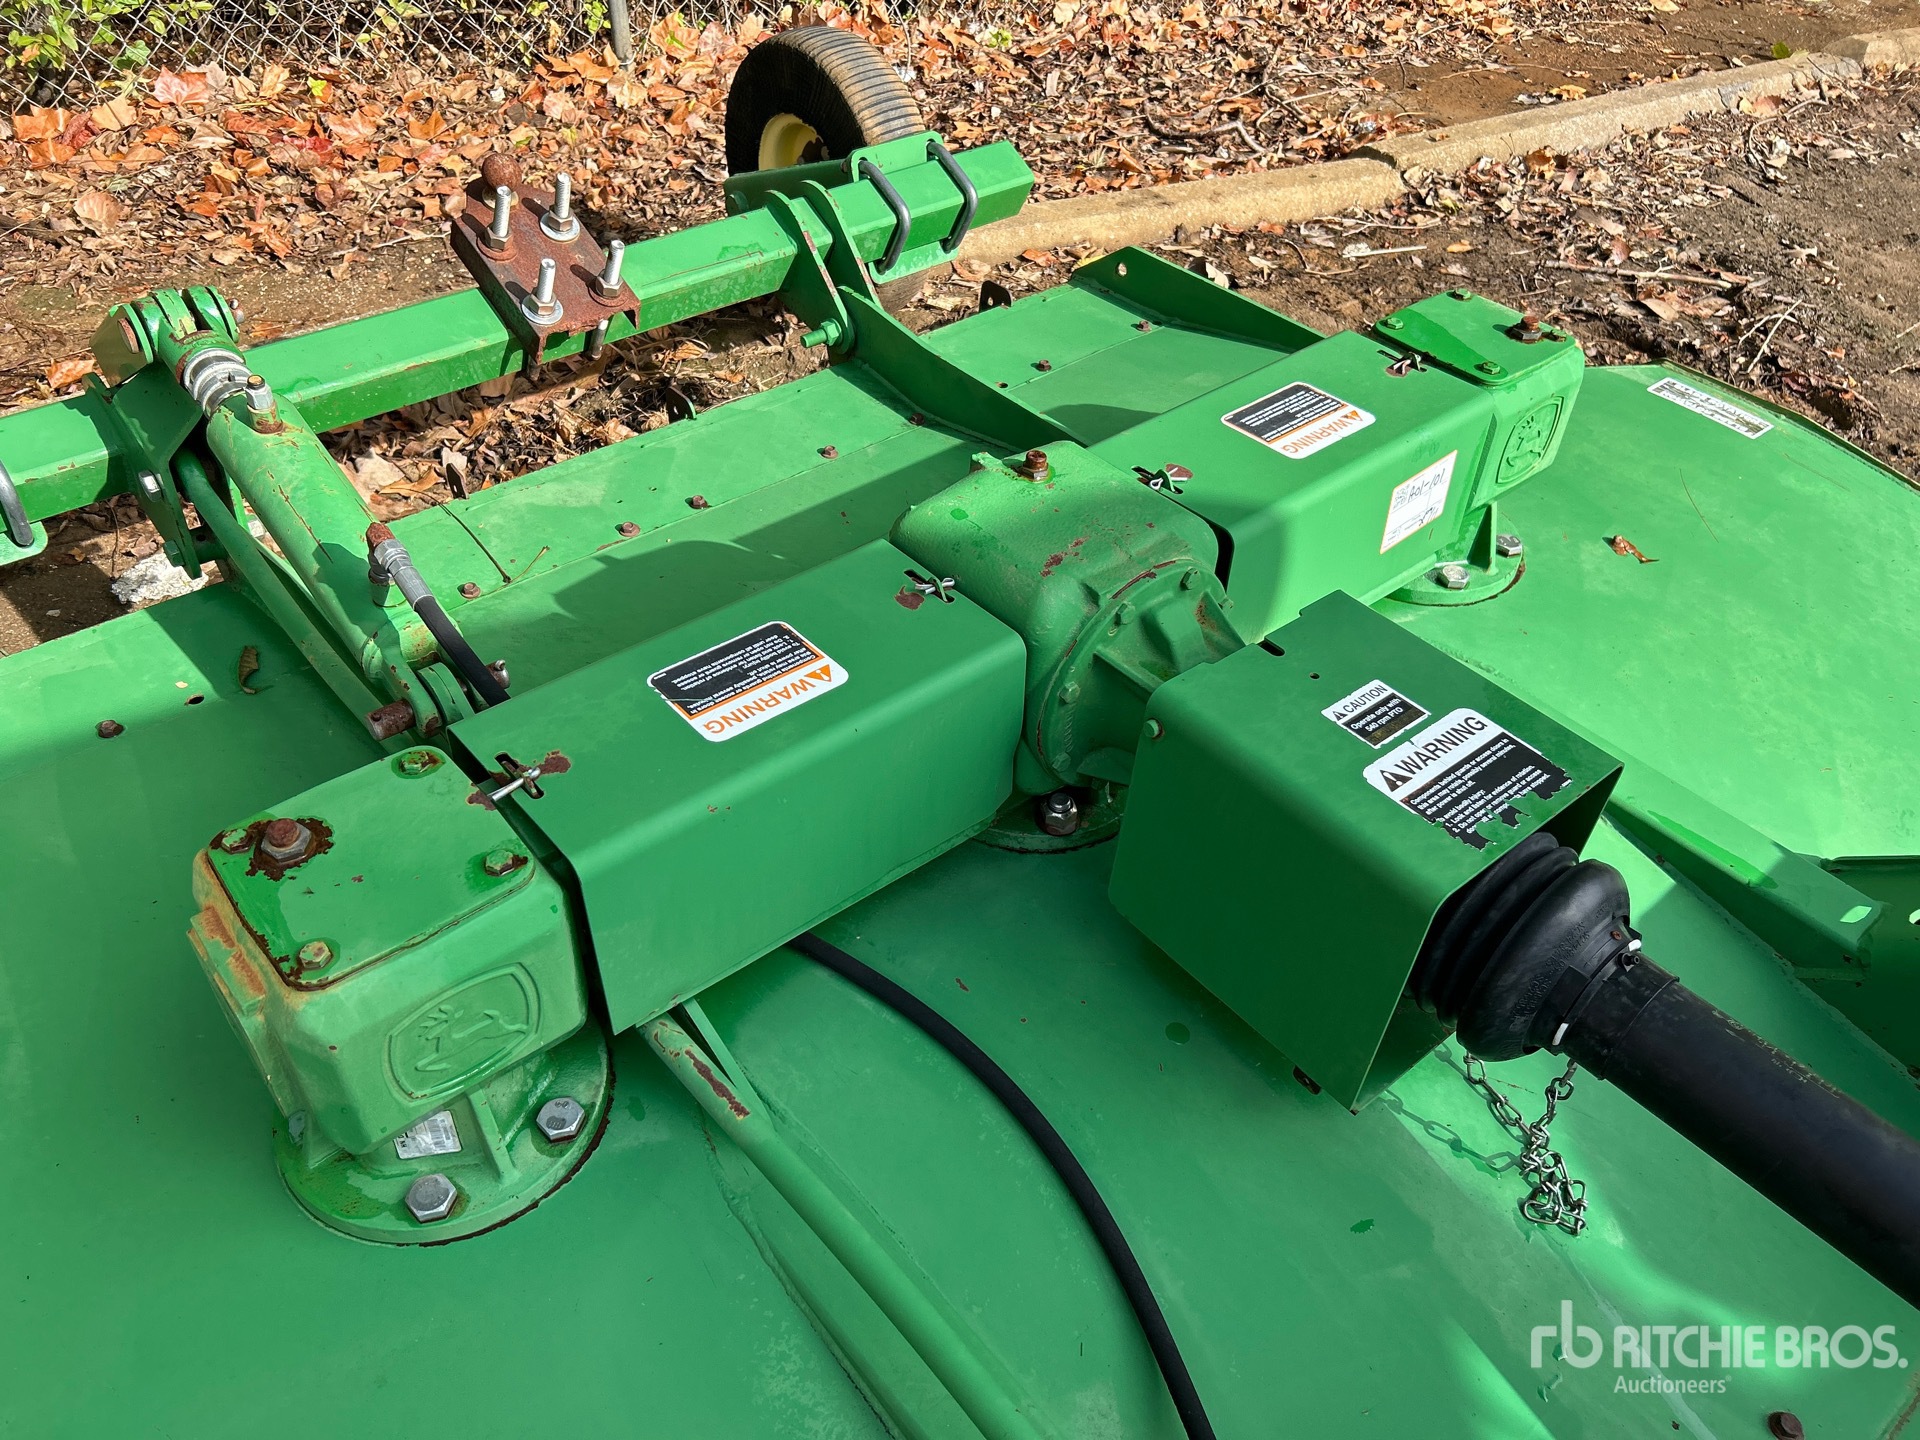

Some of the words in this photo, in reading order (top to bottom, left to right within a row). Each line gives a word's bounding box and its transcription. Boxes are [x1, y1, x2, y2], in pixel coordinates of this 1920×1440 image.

[1282, 419, 1352, 453] WARNING
[704, 679, 815, 733] WARNING
[1343, 685, 1388, 713] CAUTION
[1350, 713, 1377, 730] Operate
[1374, 705, 1390, 716] only
[1386, 698, 1402, 708] with
[1364, 722, 1379, 732] 540
[1377, 715, 1392, 725] rpm
[1387, 706, 1404, 718] PTO
[1396, 716, 1488, 774] WARNING
